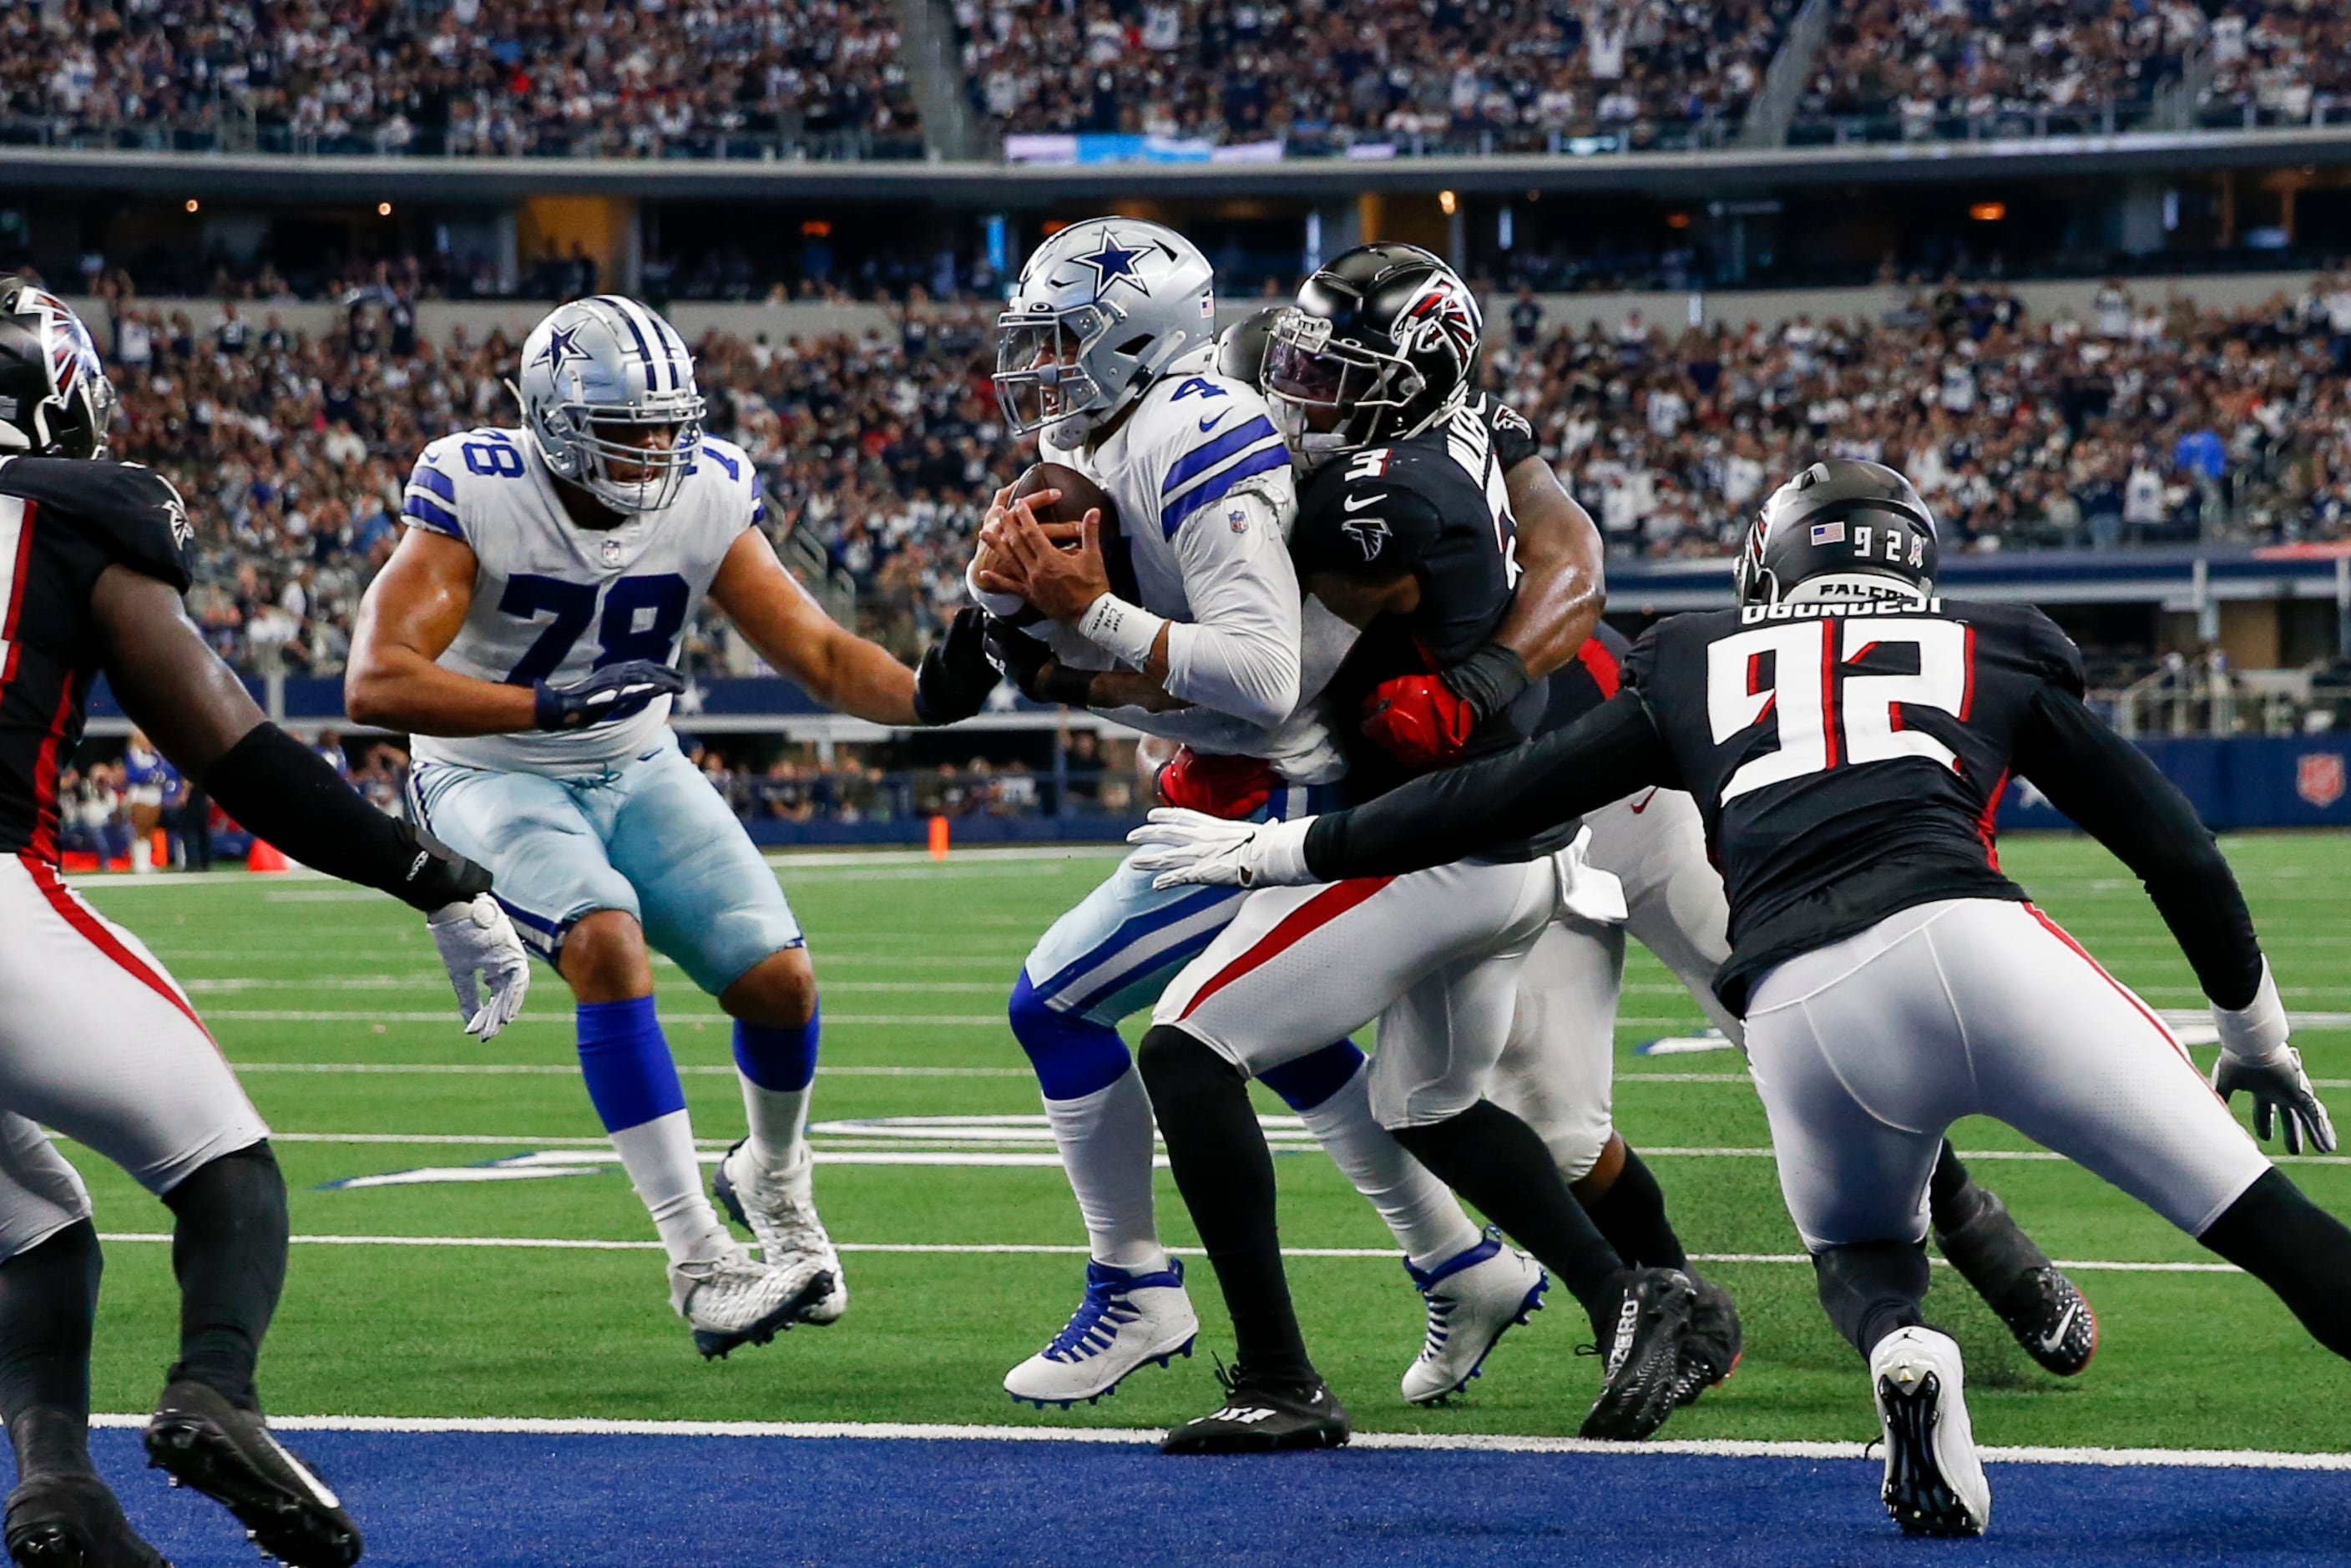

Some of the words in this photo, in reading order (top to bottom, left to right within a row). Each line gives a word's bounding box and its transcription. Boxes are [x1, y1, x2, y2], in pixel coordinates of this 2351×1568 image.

[1170, 377, 1229, 402] 4
[1344, 448, 1393, 483] 3
[1853, 526, 1903, 563] 92
[497, 572, 690, 686] 78
[1706, 617, 1975, 807] 92
